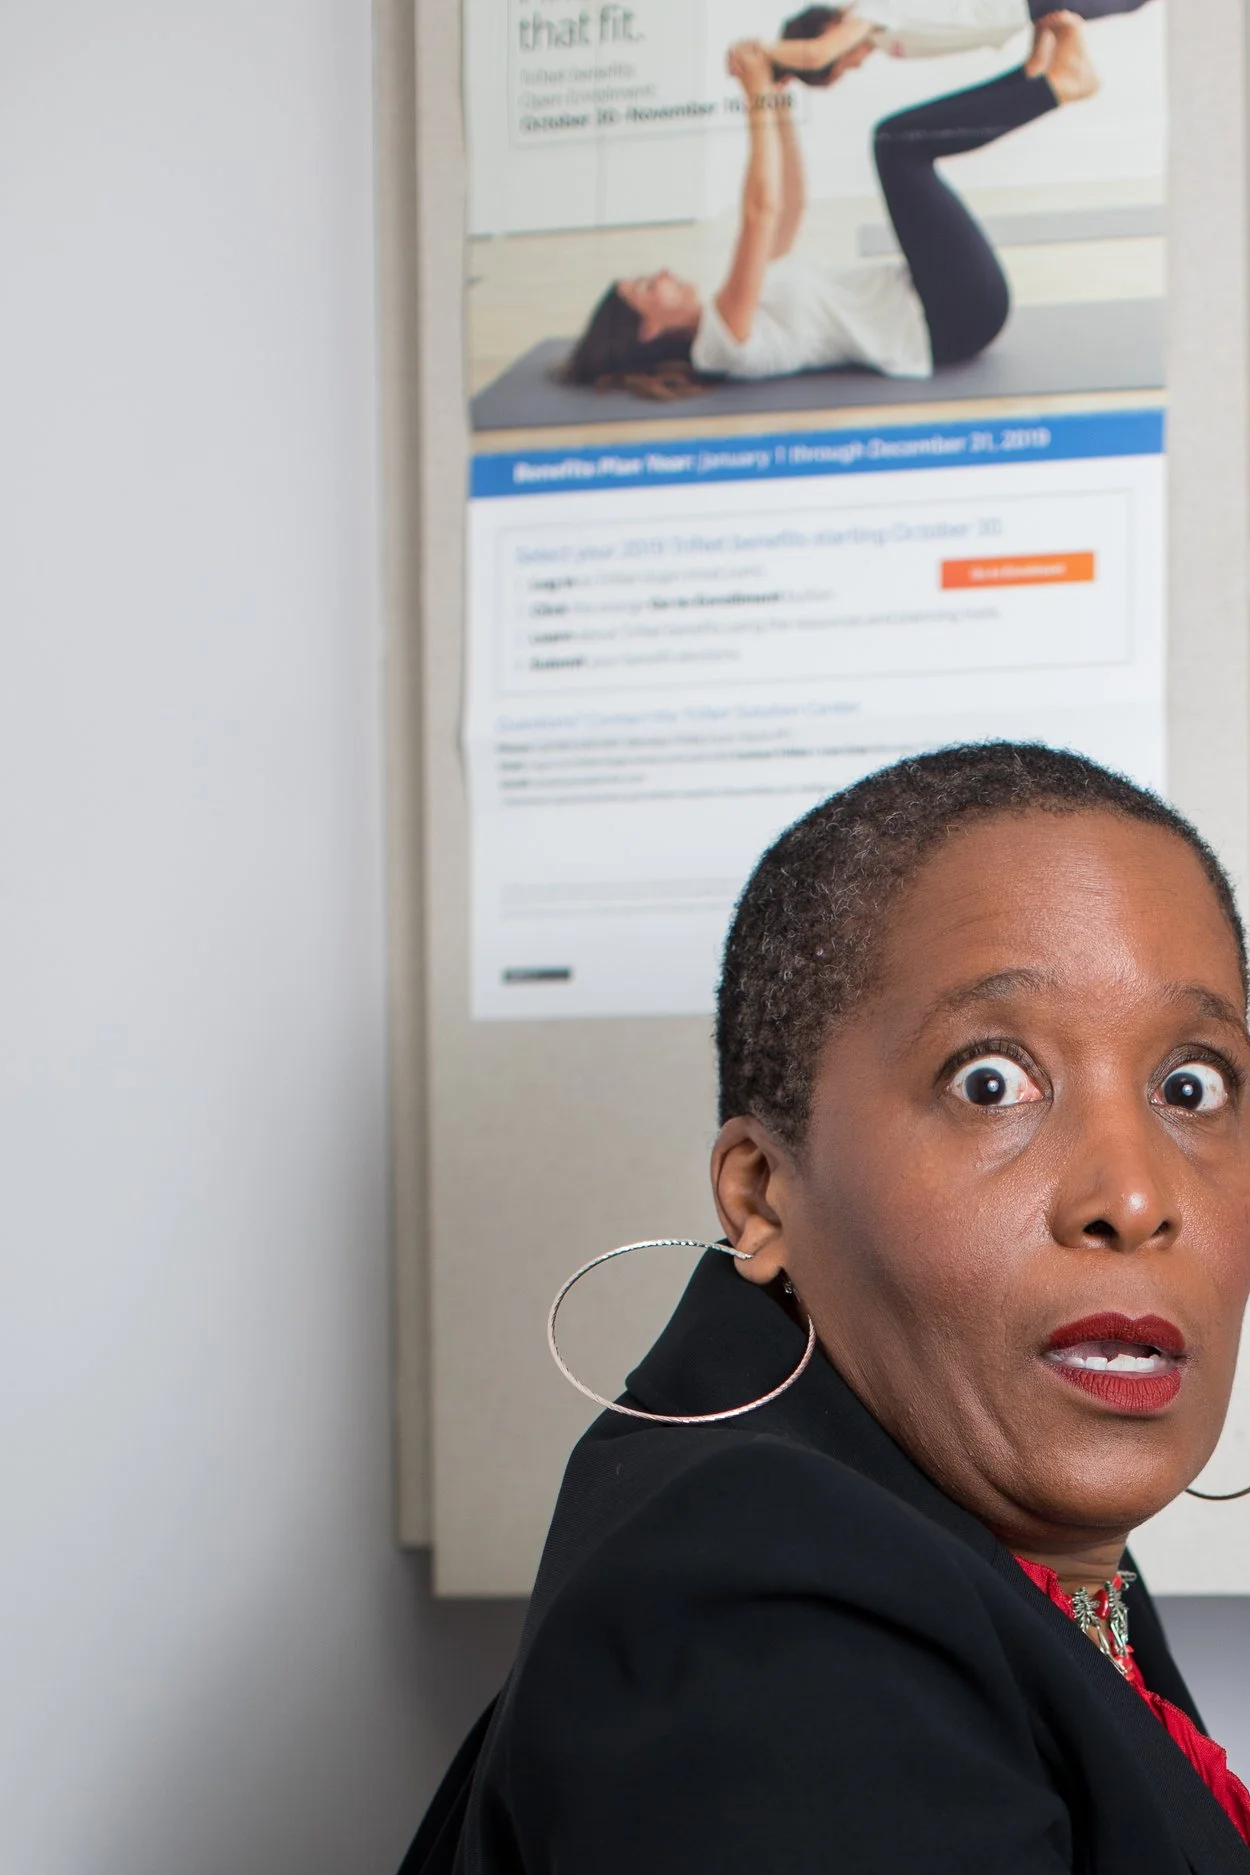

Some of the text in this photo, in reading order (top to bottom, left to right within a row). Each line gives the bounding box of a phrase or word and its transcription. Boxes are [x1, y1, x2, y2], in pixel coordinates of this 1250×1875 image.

[518, 3, 646, 52] that fit.
[789, 441, 863, 467] through
[866, 435, 966, 461] December
